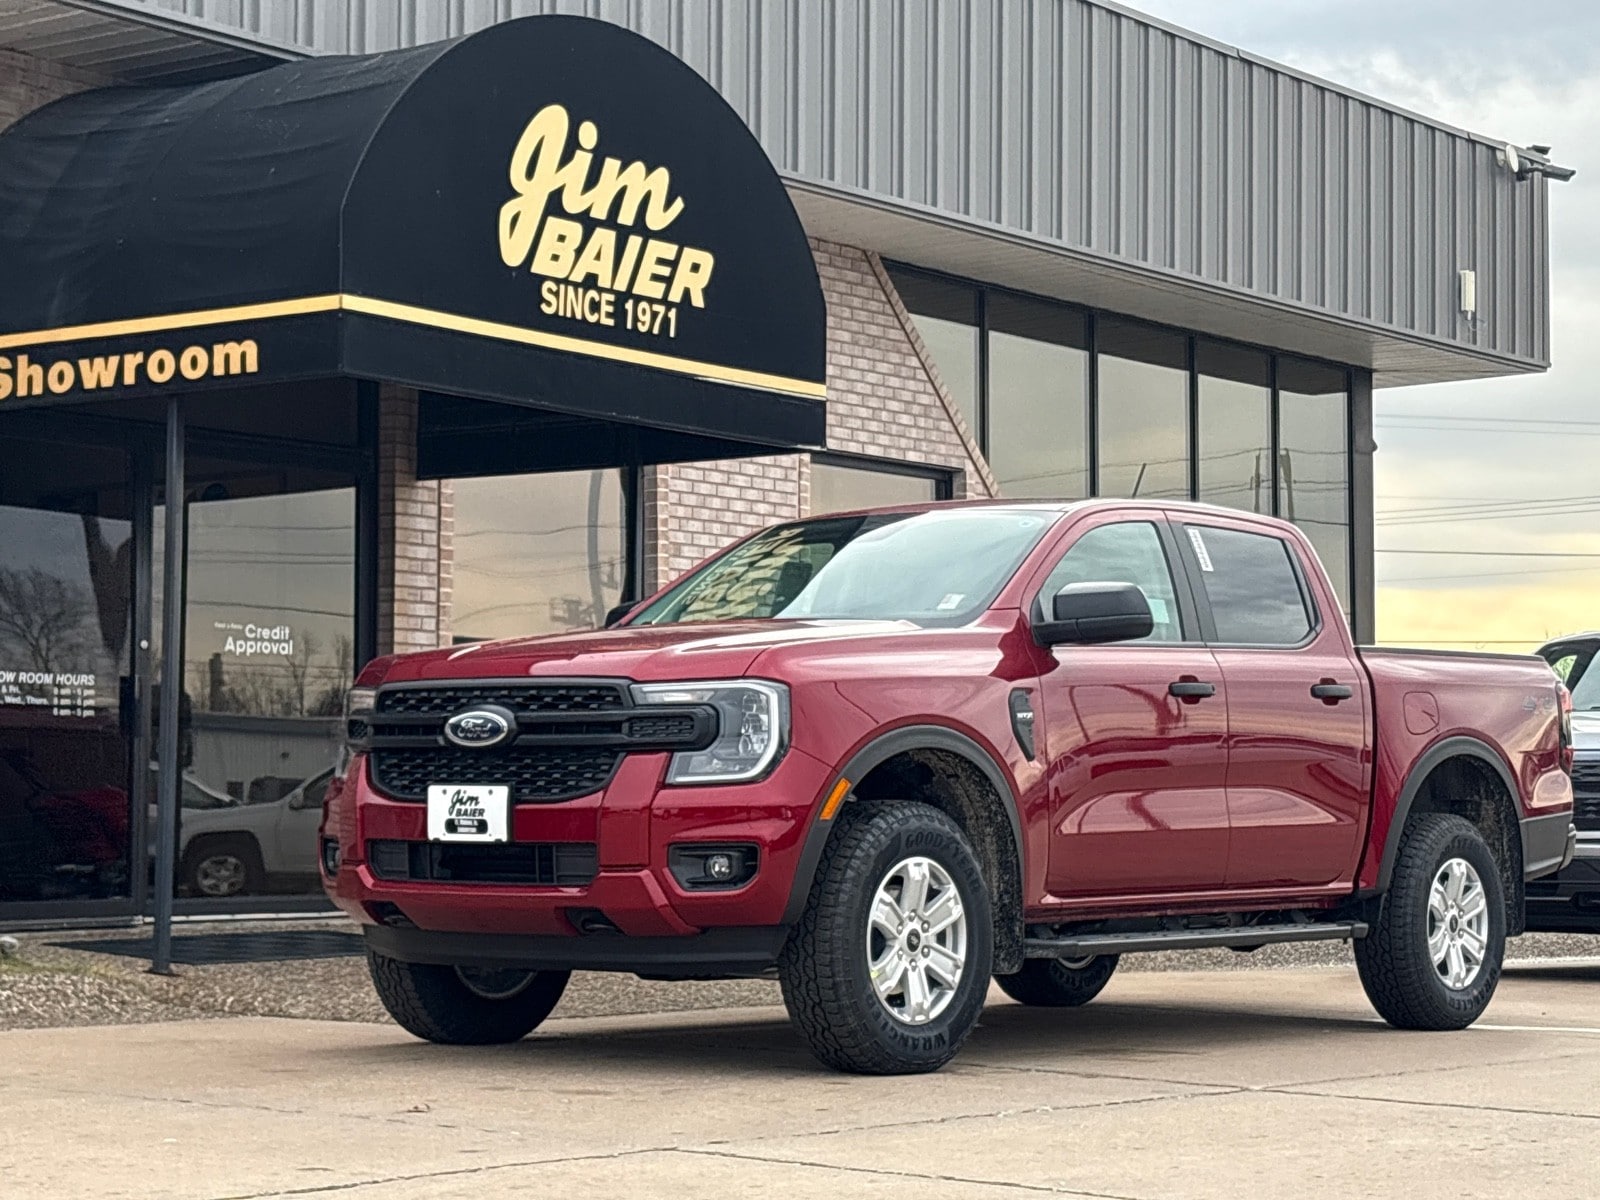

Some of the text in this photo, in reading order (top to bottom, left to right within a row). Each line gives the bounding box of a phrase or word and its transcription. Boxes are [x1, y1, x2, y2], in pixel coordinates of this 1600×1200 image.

[499, 104, 685, 267] Jim
[530, 216, 714, 308] BAIER
[540, 280, 677, 338] SINCE 1971
[245, 624, 290, 641] Credit
[224, 636, 294, 656] Approval
[18, 671, 54, 685] ROOM
[55, 673, 96, 687] HOURS
[448, 789, 480, 816] Jim
[455, 808, 485, 818] BAIER
